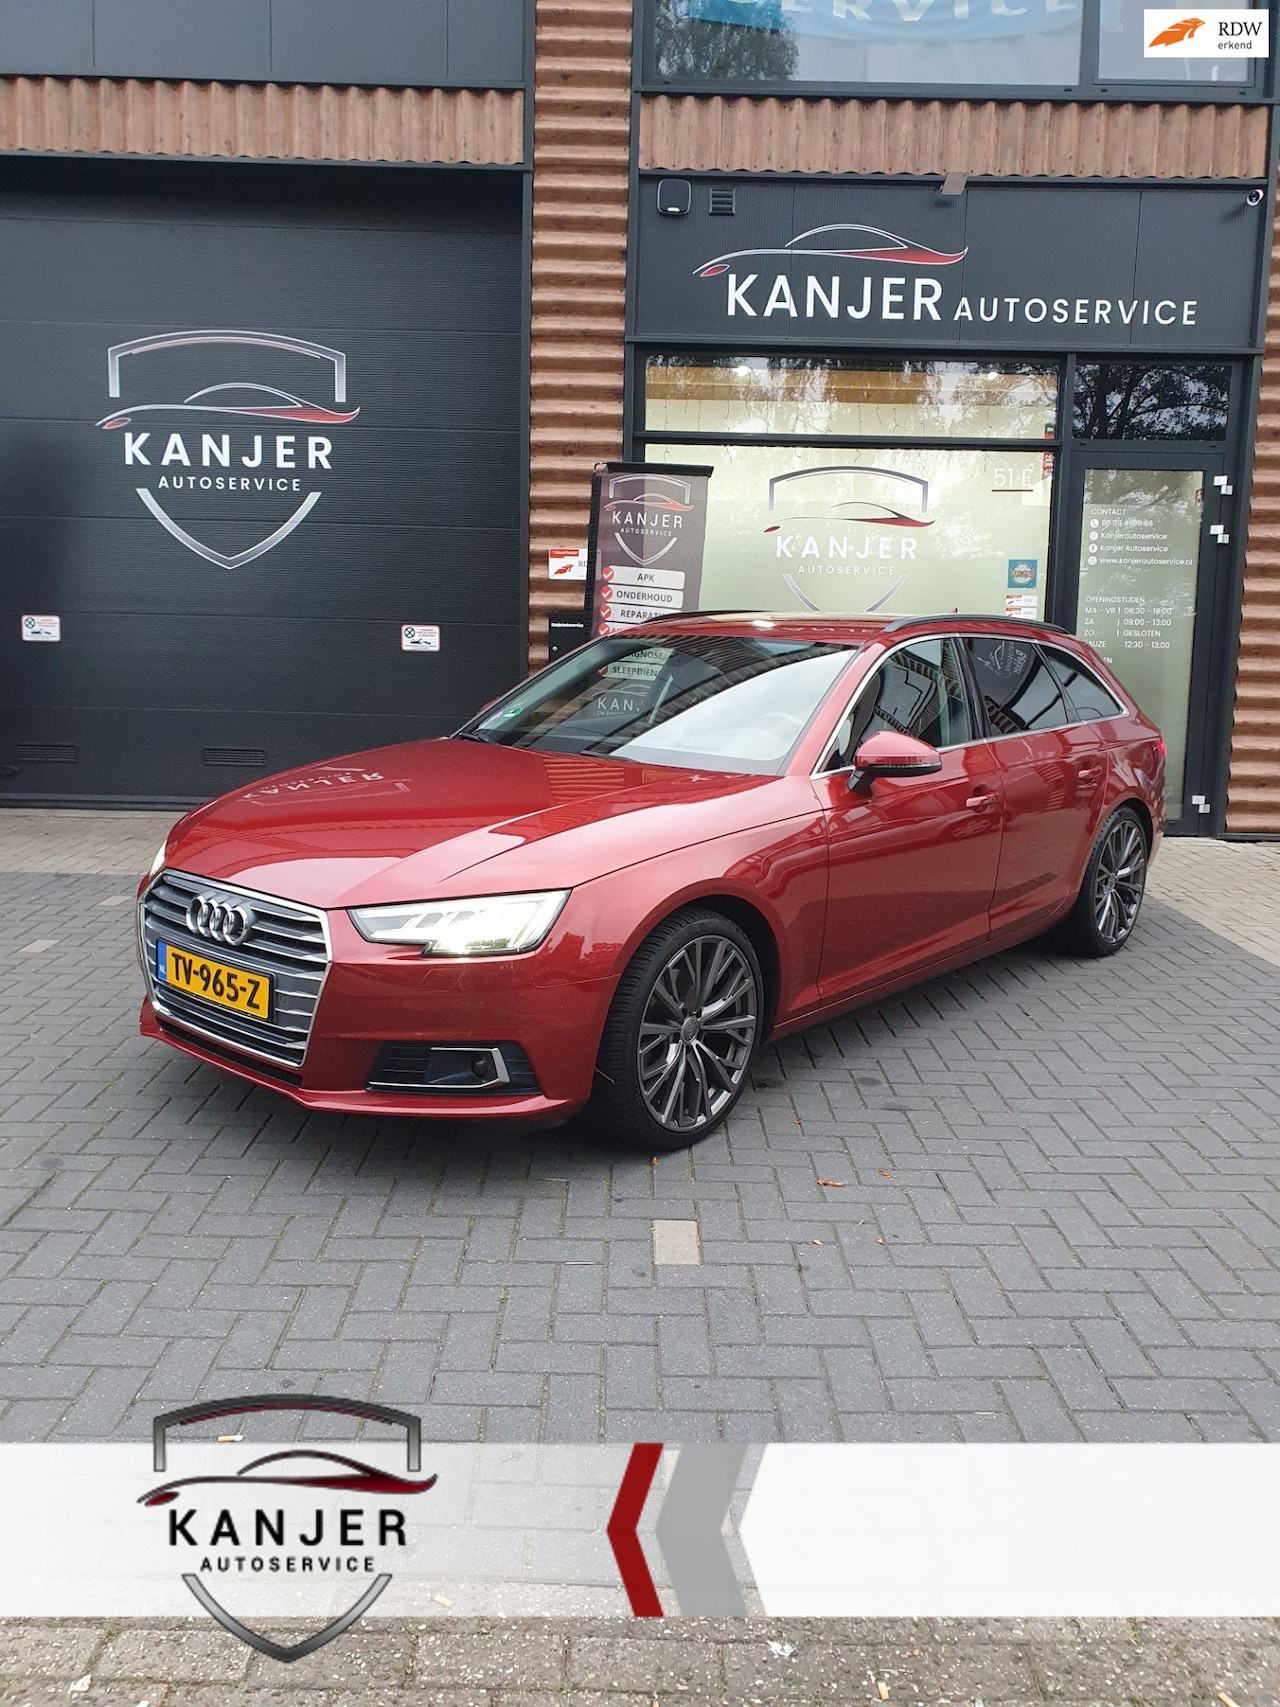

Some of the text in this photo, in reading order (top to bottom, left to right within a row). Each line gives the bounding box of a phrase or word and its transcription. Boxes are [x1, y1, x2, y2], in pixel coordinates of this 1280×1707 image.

[727, 273, 1198, 325] KANJER AUTOSERVICE
[124, 432, 333, 469] KANJER
[158, 475, 301, 491] AUTOSERVICE
[994, 468, 1033, 487] 51 E
[612, 510, 683, 529] KANJER
[620, 527, 672, 537] AUTOSERVICE
[776, 535, 917, 560] KANJER
[1100, 545, 1169, 553] Kanjer Autoservice
[798, 565, 895, 575] AUTOSERVICE
[637, 573, 655, 583] APK
[616, 590, 673, 602] ONDERHOUD
[620, 610, 665, 619] REPARAT
[612, 666, 659, 676] SLEEPDIEN
[171, 952, 260, 1010] TV-965-Z
